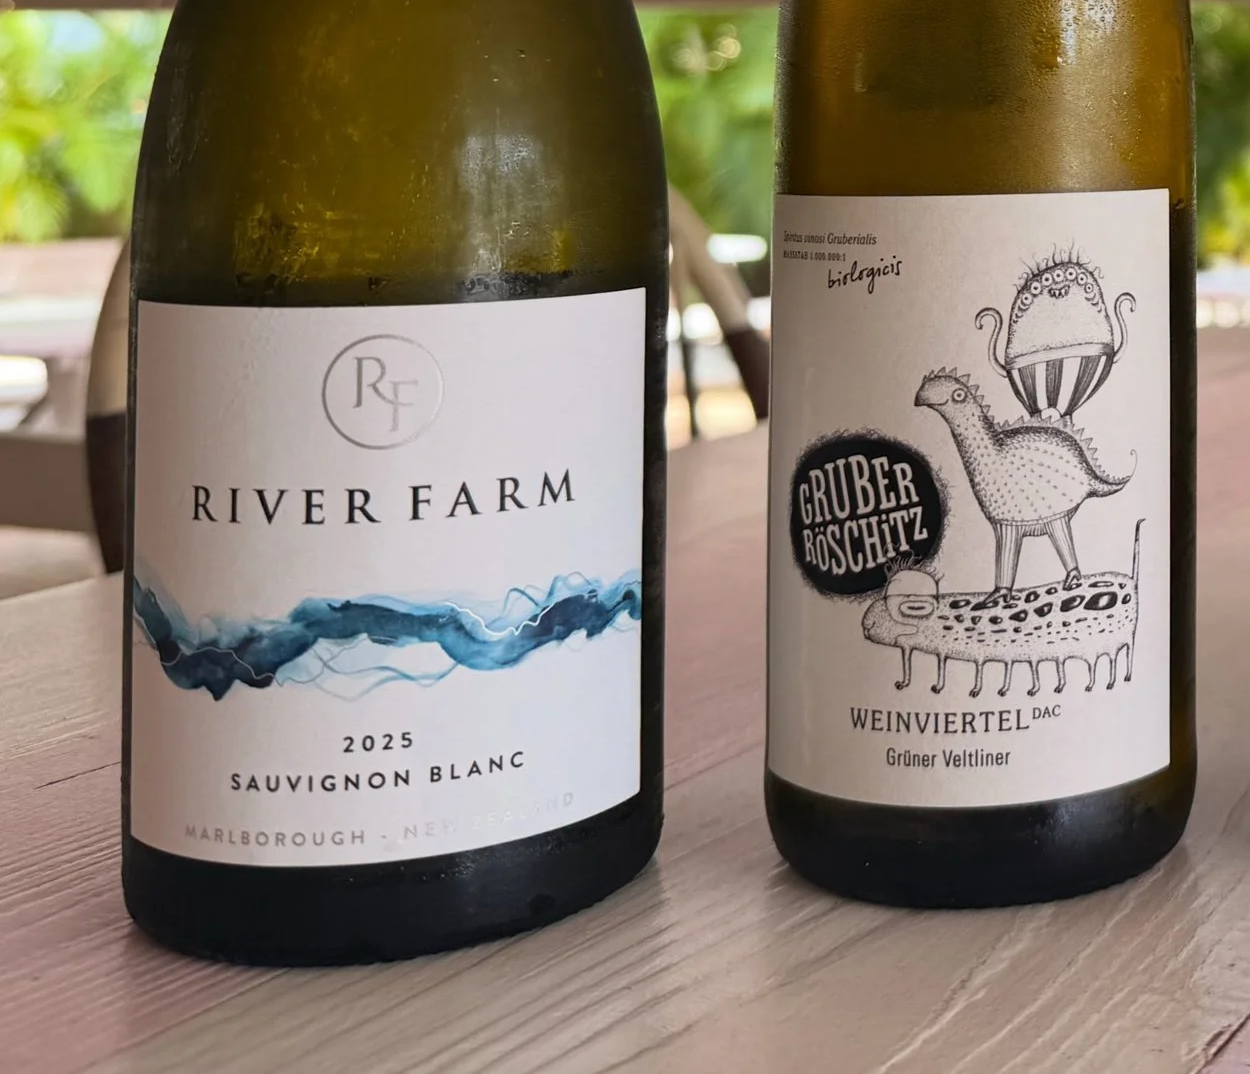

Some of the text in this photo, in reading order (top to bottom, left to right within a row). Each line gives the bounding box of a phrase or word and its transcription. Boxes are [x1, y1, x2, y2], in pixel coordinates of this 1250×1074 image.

[827, 233, 877, 246] Gruberialis
[828, 255, 903, 294] biologicis
[191, 468, 576, 526] RIVER FARM
[799, 454, 920, 525] GRUBER
[850, 704, 1061, 734] WEINVIERTEL DAC
[343, 732, 414, 754] 2025
[886, 747, 1011, 768] Grüner Veltliner
[230, 751, 526, 793] SAUVIGNON BLANC
[185, 825, 366, 847] MARLBOROUGH
